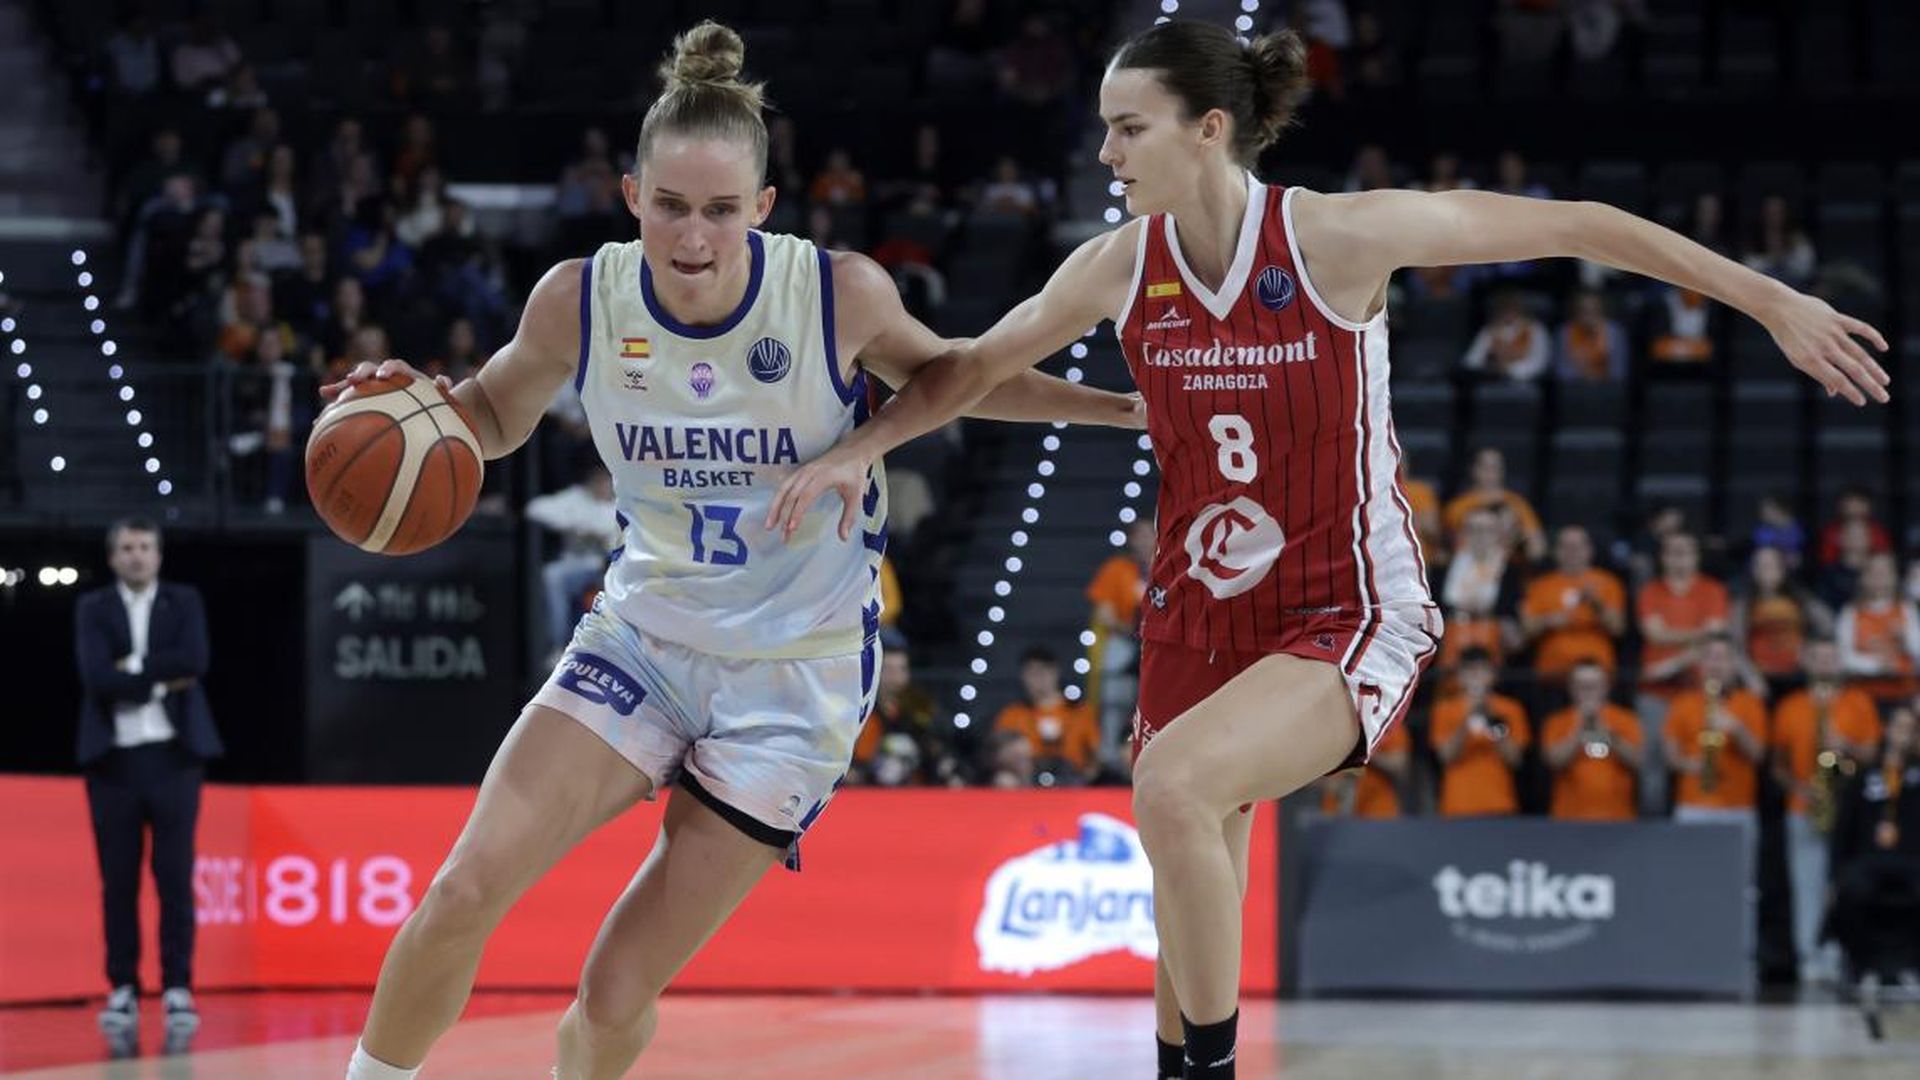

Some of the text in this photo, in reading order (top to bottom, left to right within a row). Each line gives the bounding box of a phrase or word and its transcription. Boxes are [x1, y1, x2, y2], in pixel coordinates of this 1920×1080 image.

[1143, 331, 1318, 367] Casademont
[1182, 374, 1268, 390] ZARAGOZA
[615, 423, 799, 464] VALENCIA
[1208, 414, 1257, 483] 8
[663, 467, 755, 488] BASKET
[683, 502, 748, 566] 13
[335, 634, 486, 681] SALIDA
[1000, 876, 1154, 939] Lanjar
[1433, 859, 1616, 920] teika
